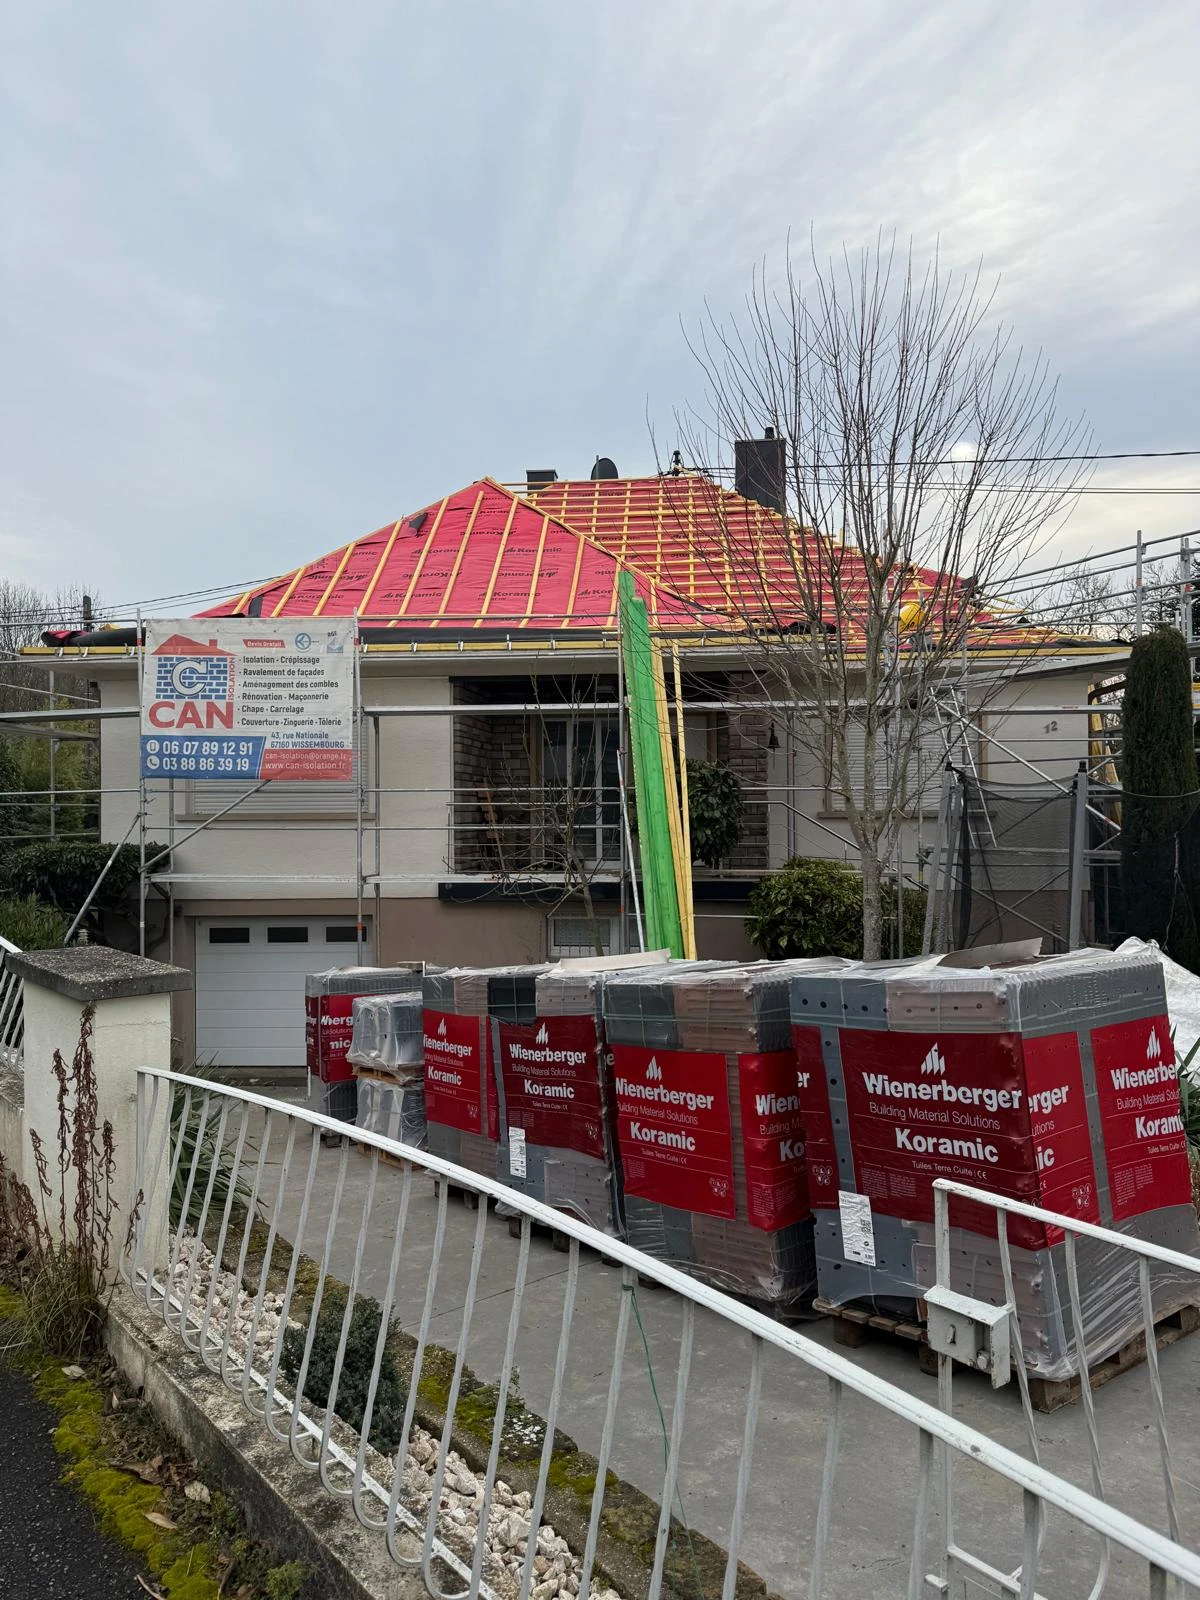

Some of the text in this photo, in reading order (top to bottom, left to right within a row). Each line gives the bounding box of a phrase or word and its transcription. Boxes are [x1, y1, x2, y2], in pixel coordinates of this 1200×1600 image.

[243, 655, 320, 665] Isolation Crépissage
[228, 657, 236, 700] ISOLATION
[243, 668, 325, 678] Ravalement de façades
[242, 681, 294, 690] Aménagement
[309, 680, 339, 688] combles
[242, 692, 329, 702] Rénovation Maçonnerie
[148, 701, 234, 729] CAN
[241, 705, 305, 714] Chape Carrelage
[241, 718, 279, 726] Couverture
[318, 717, 342, 726] Tôlerie
[1043, 720, 1058, 734] 12
[295, 731, 329, 739] Nationale
[162, 741, 253, 756] 06 07 89 12 91
[162, 758, 250, 771] 03 88 86 39 19
[264, 761, 346, 770] www.can-isolation.fr
[509, 1043, 587, 1066] Wienerberger
[428, 1065, 462, 1086] Koramic
[511, 1063, 577, 1078] Building Material Solutions
[524, 1078, 575, 1099] Koramic
[862, 1071, 1022, 1112] Wienerberger
[1117, 1095, 1143, 1110] Building
[1143, 1091, 1165, 1106] Material
[639, 1103, 665, 1119] Material
[666, 1109, 698, 1125] Solutions
[869, 1101, 1000, 1130] Building Material Solutions
[759, 1121, 790, 1136] Building
[1135, 1109, 1184, 1139] Korami
[630, 1121, 696, 1151] Koramic
[779, 1138, 805, 1162] Ko
[894, 1127, 999, 1163] Koramic
[912, 1160, 932, 1170] Tuiles
[933, 1162, 952, 1172] Terre
[953, 1165, 973, 1177] Cuite
